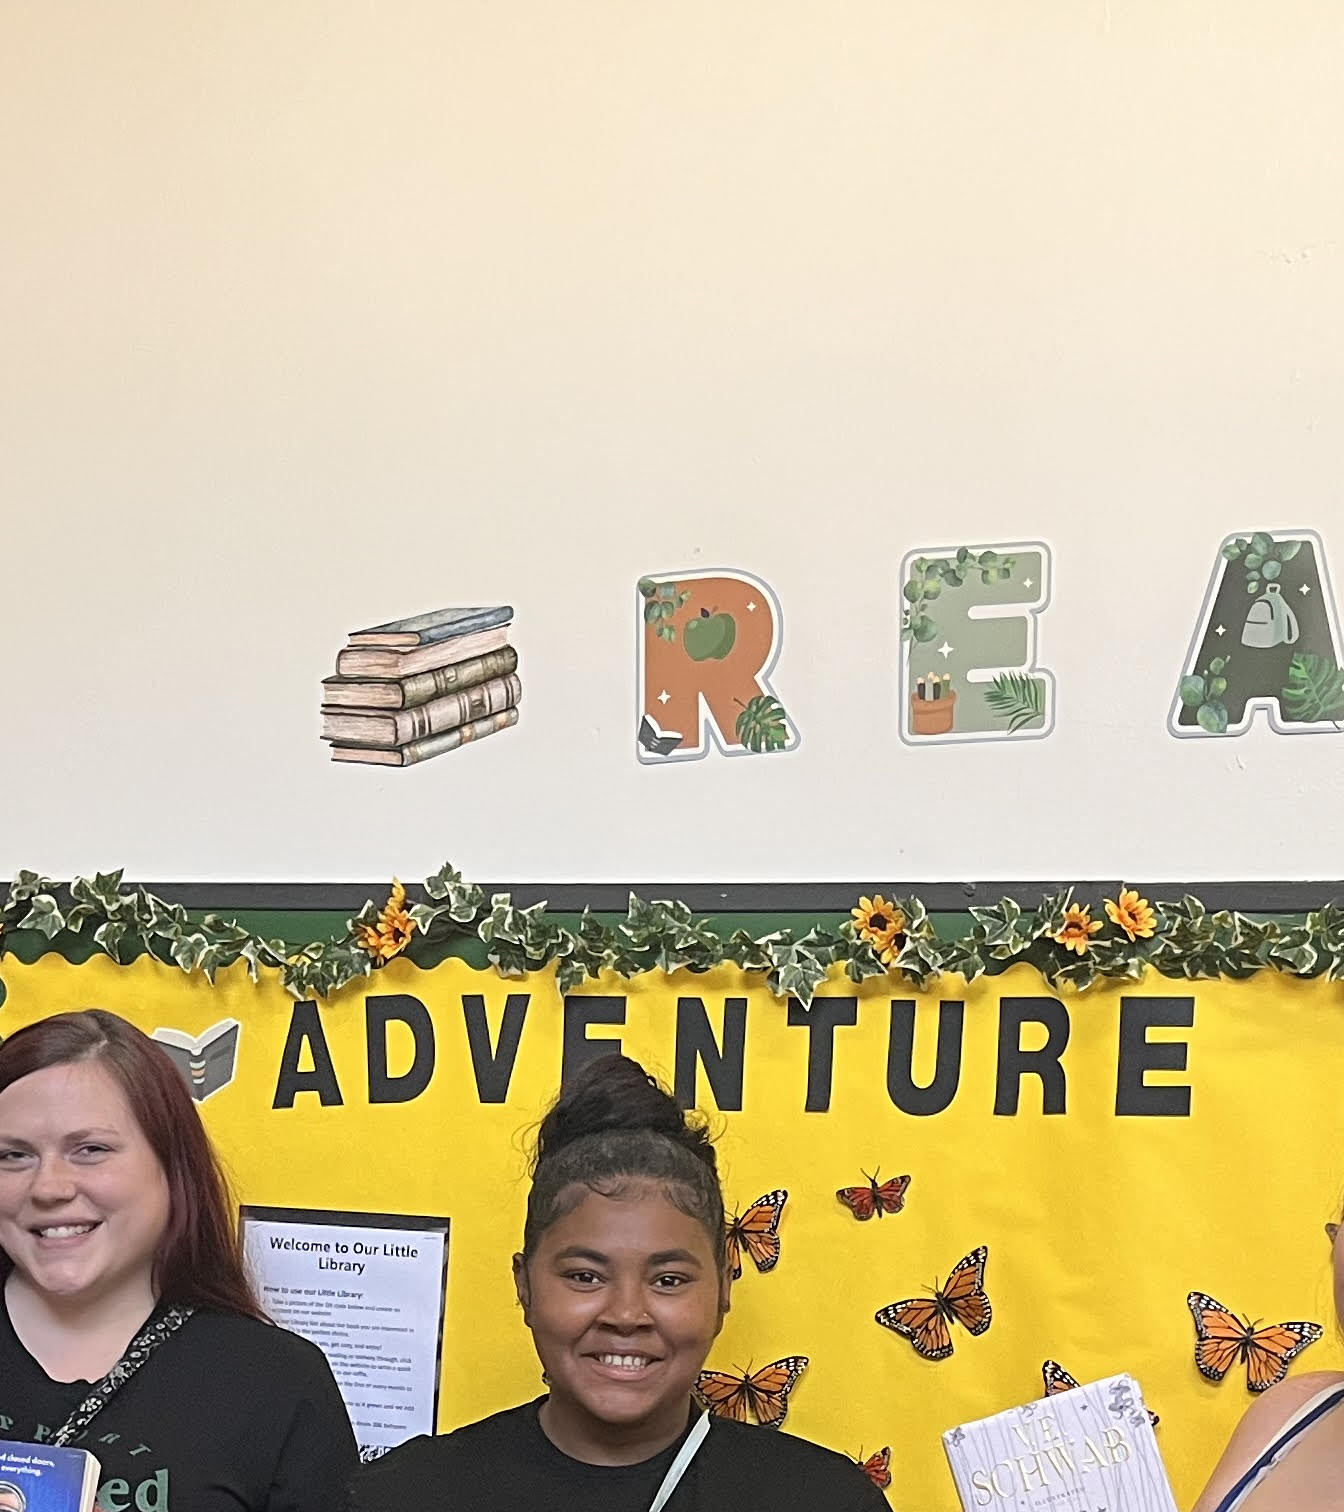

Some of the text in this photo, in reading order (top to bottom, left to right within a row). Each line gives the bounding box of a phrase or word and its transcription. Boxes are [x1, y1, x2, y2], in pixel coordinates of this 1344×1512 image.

[272, 994, 1194, 1118] ADVENTURE
[270, 1236, 418, 1259] Welcome to Our Little
[318, 1257, 366, 1276] Library
[971, 1427, 1131, 1507] SCHWAB
